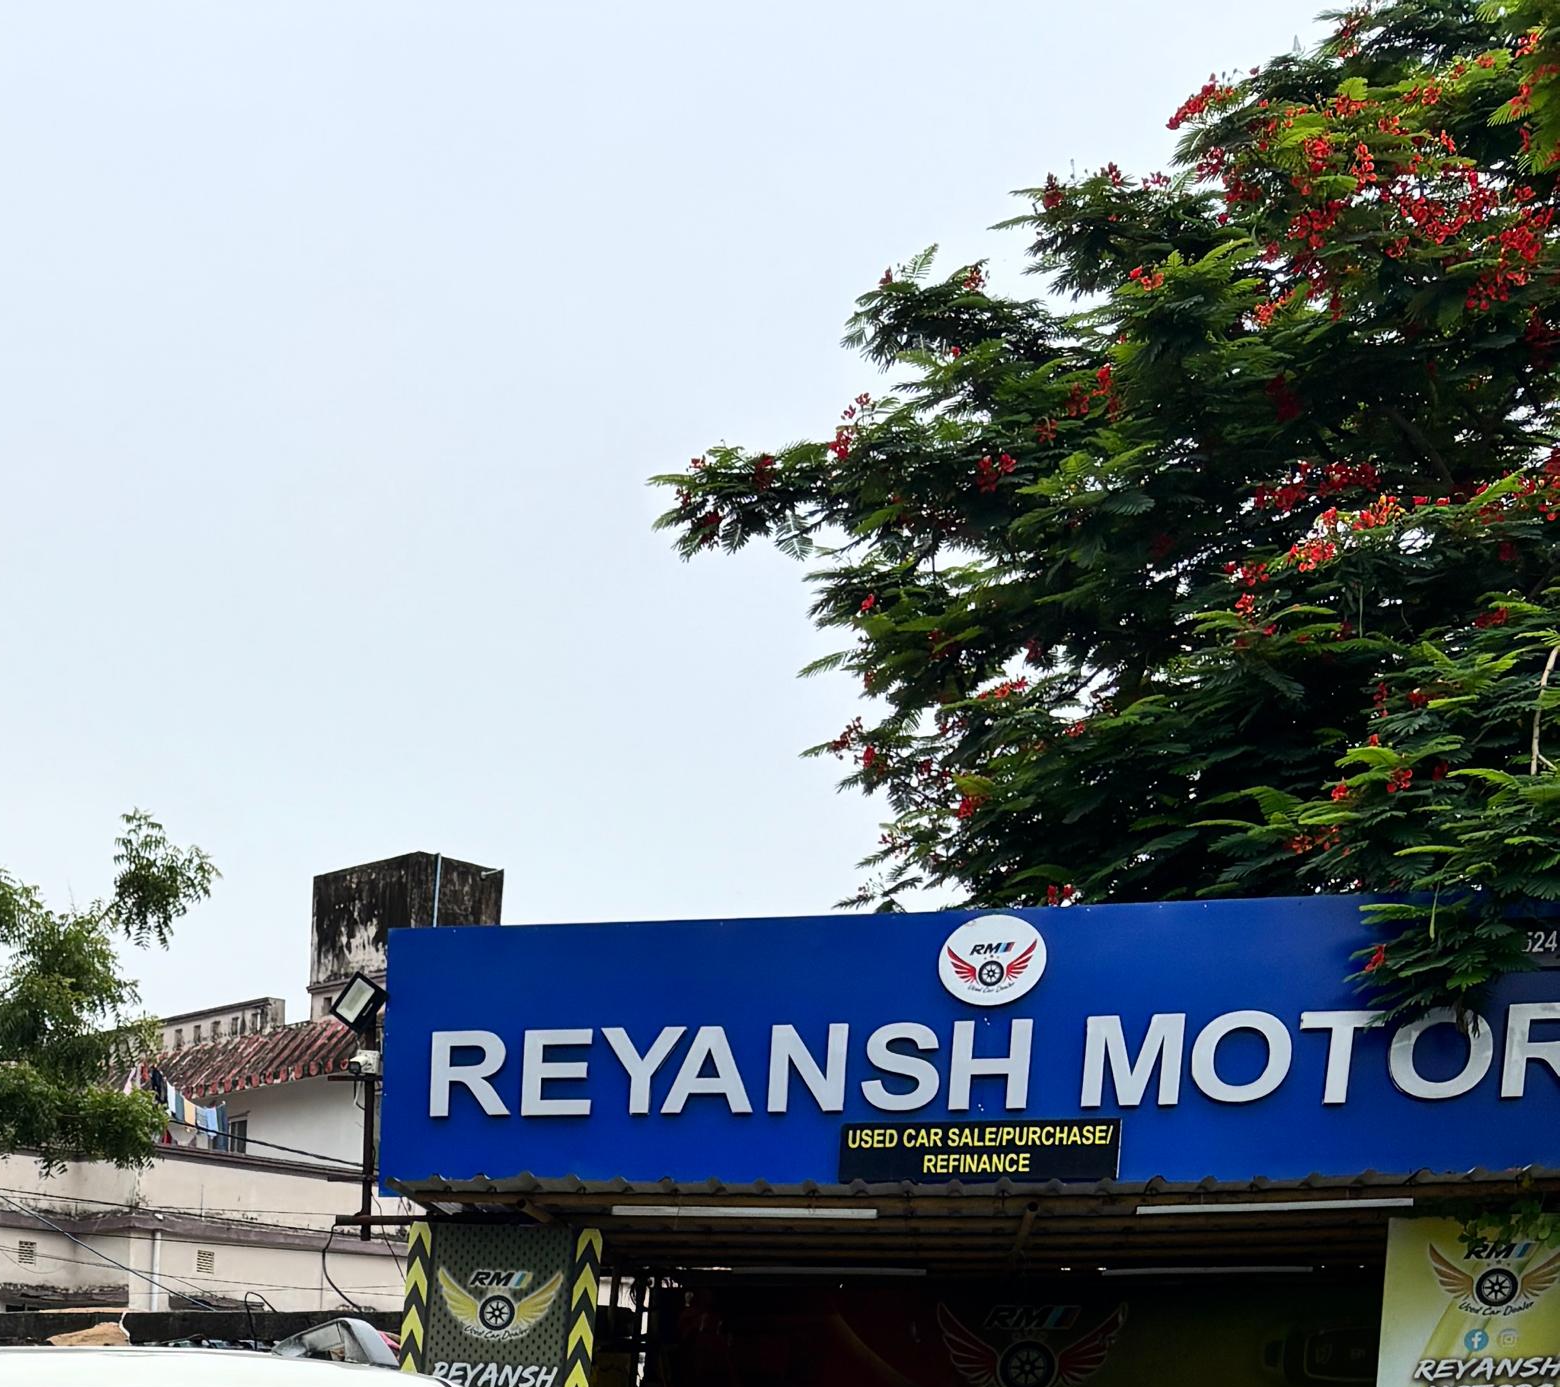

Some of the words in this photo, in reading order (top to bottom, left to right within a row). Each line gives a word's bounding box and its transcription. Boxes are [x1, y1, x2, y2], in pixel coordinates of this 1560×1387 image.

[430, 1019, 1033, 1117] REYANSH
[847, 1129, 898, 1149] USED
[903, 1128, 942, 1148] CAR
[947, 1125, 1114, 1147] SALE/PURCHASE/
[922, 1153, 1031, 1174] REFINANCE
[1458, 1302, 1481, 1315] Used
[1482, 1307, 1502, 1316] Car
[1502, 1301, 1535, 1316] Dealer
[464, 1325, 484, 1337] Used
[484, 1331, 501, 1341] Car
[502, 1328, 530, 1341] Dealer
[1414, 1357, 1560, 1382] REYANSH
